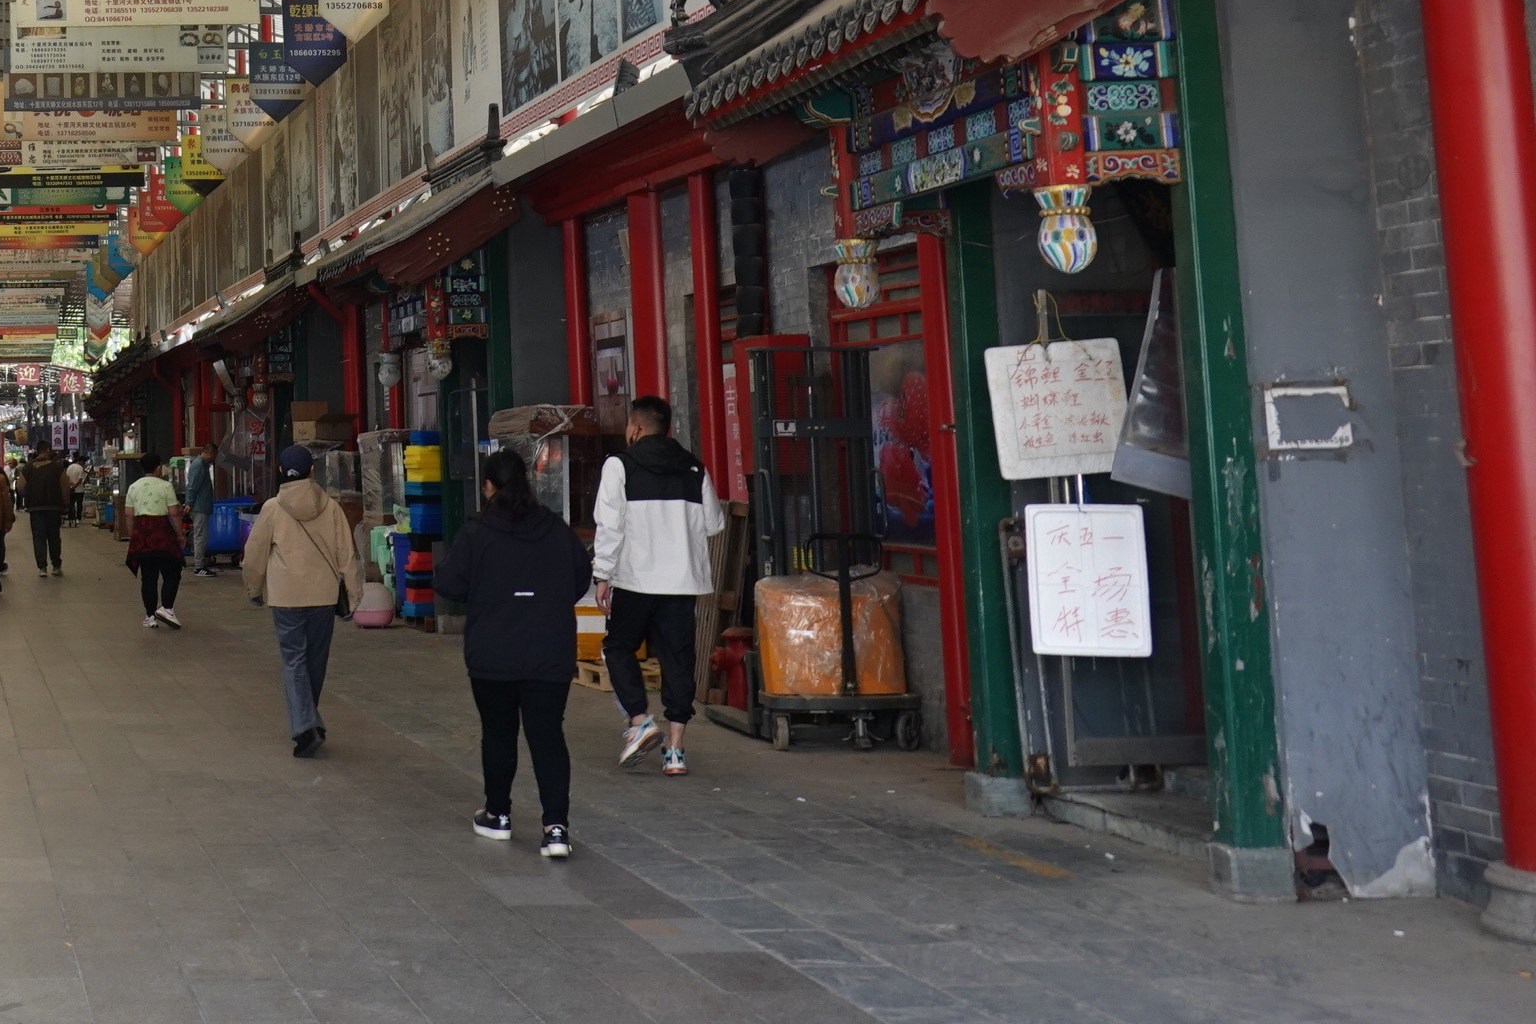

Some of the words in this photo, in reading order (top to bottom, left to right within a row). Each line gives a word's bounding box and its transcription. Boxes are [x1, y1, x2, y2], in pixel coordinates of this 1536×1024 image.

[326, 2, 383, 10] 13552706838
[289, 49, 341, 57] 18660375295
[19, 365, 39, 382] 迎
[63, 373, 81, 392] 您
[1047, 521, 1124, 546] 庆五一
[1047, 563, 1132, 602] 全场
[1052, 606, 1139, 643] 特惠
